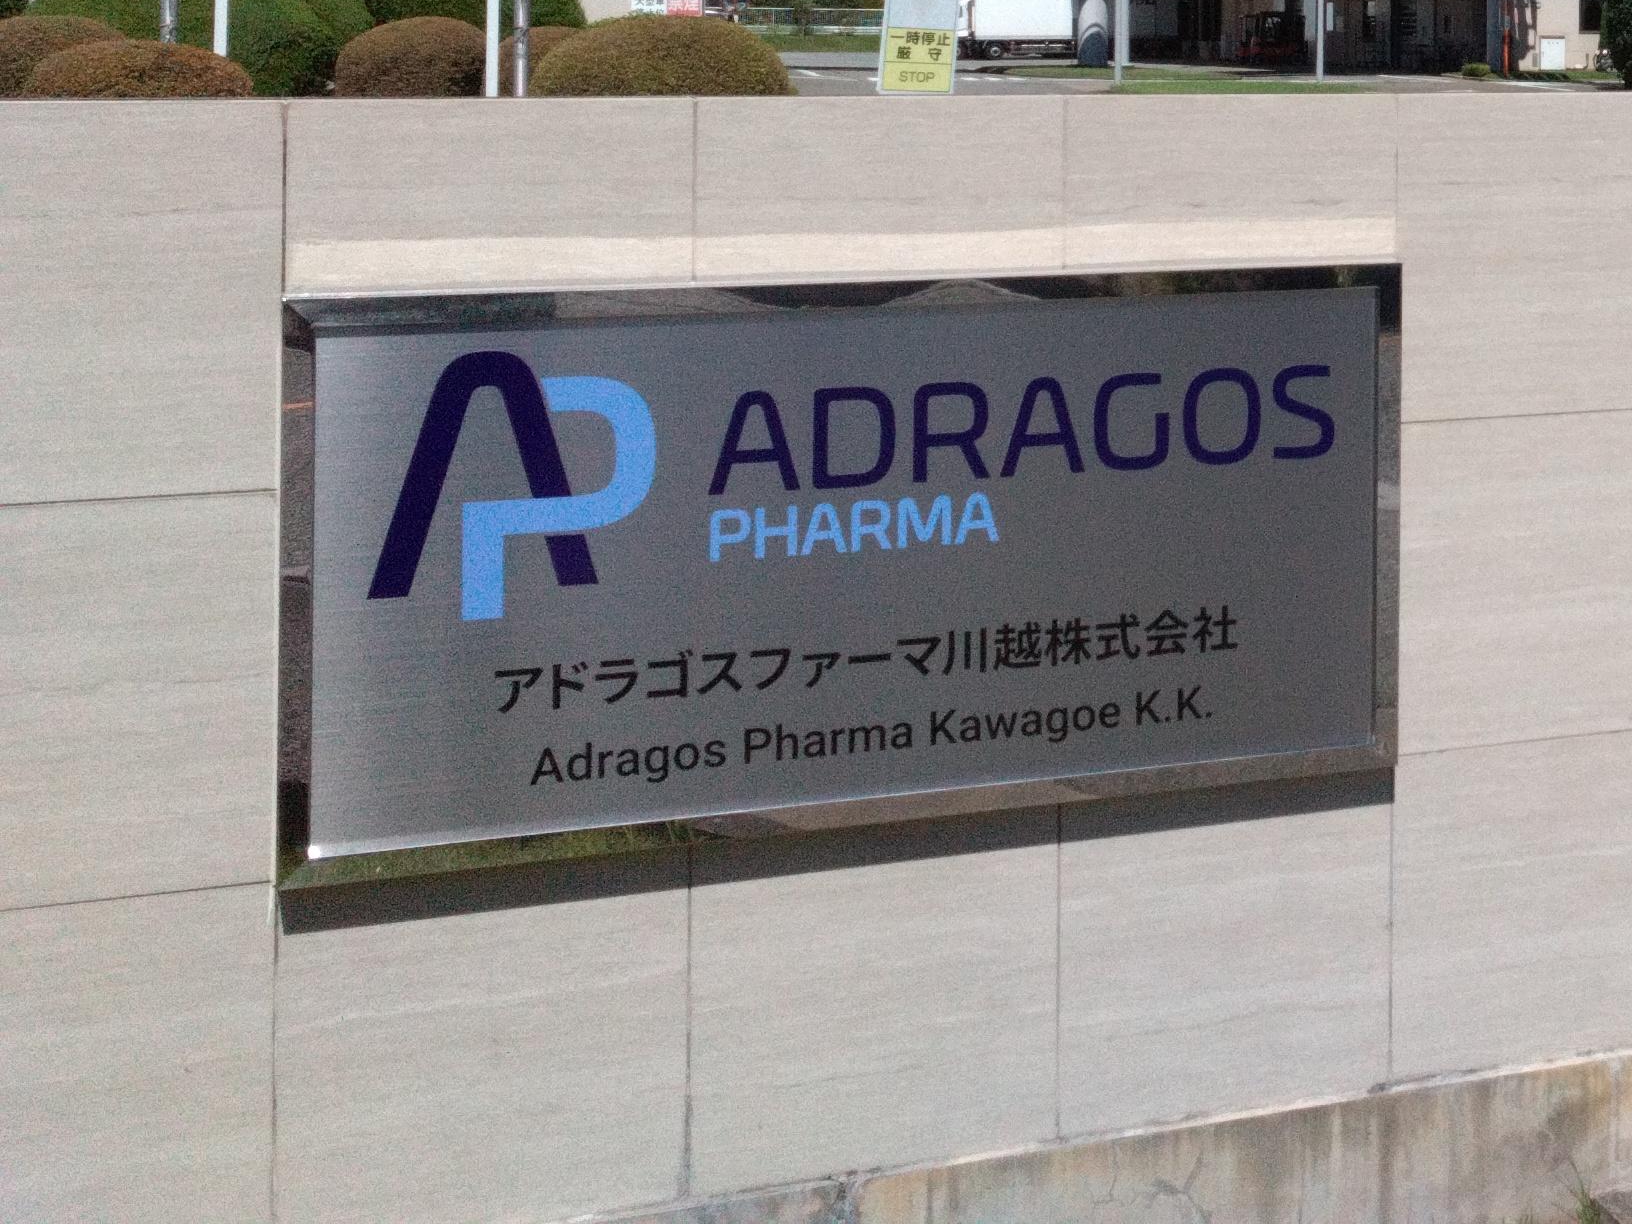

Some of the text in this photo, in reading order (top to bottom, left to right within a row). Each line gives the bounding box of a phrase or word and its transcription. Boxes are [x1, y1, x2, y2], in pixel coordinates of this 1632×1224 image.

[890, 31, 951, 46] 一時停止
[898, 70, 936, 83] STOP
[708, 364, 1338, 495] ADRAGOS
[708, 491, 1002, 563] PHARMA
[493, 604, 1241, 715] アドラゴスファーマ川越株式会社
[530, 685, 1214, 786] Adragos Pharma Kawagoe K.K.
